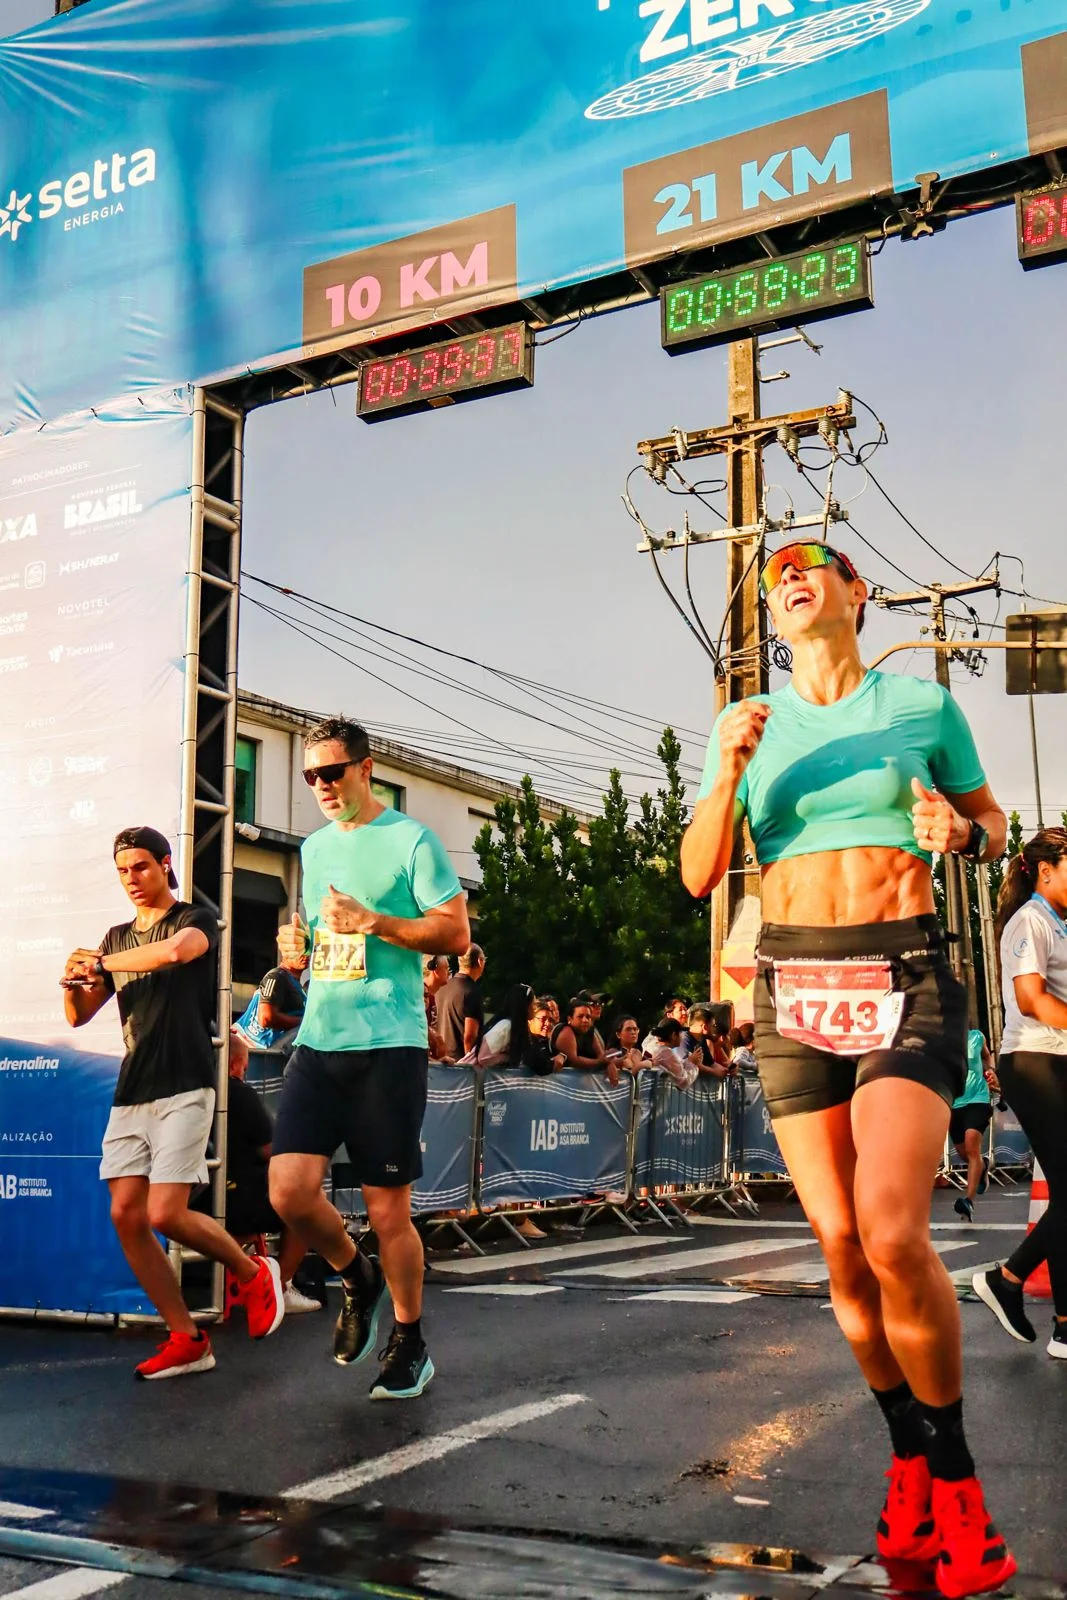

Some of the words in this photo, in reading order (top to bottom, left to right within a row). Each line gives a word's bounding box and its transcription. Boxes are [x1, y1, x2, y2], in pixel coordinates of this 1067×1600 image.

[38, 148, 156, 219] setta
[653, 174, 717, 236] 21
[741, 131, 853, 211] KM
[63, 202, 125, 232] ENERGIA
[325, 275, 382, 329] 10
[399, 241, 489, 309] KM
[668, 245, 858, 333] 00:59:23
[64, 489, 143, 530] BRASIL
[0, 512, 38, 544] XA
[57, 598, 111, 616] NOVOTEL
[788, 1000, 879, 1034] 1743
[0, 1131, 54, 1144] ALIZAÇÃO
[530, 1119, 559, 1152] IAB
[559, 1135, 570, 1146] ASA
[569, 1134, 590, 1145] BRANCA
[560, 1122, 586, 1134] INSTITUTO
[18, 1178, 48, 1188] INSTITUTO
